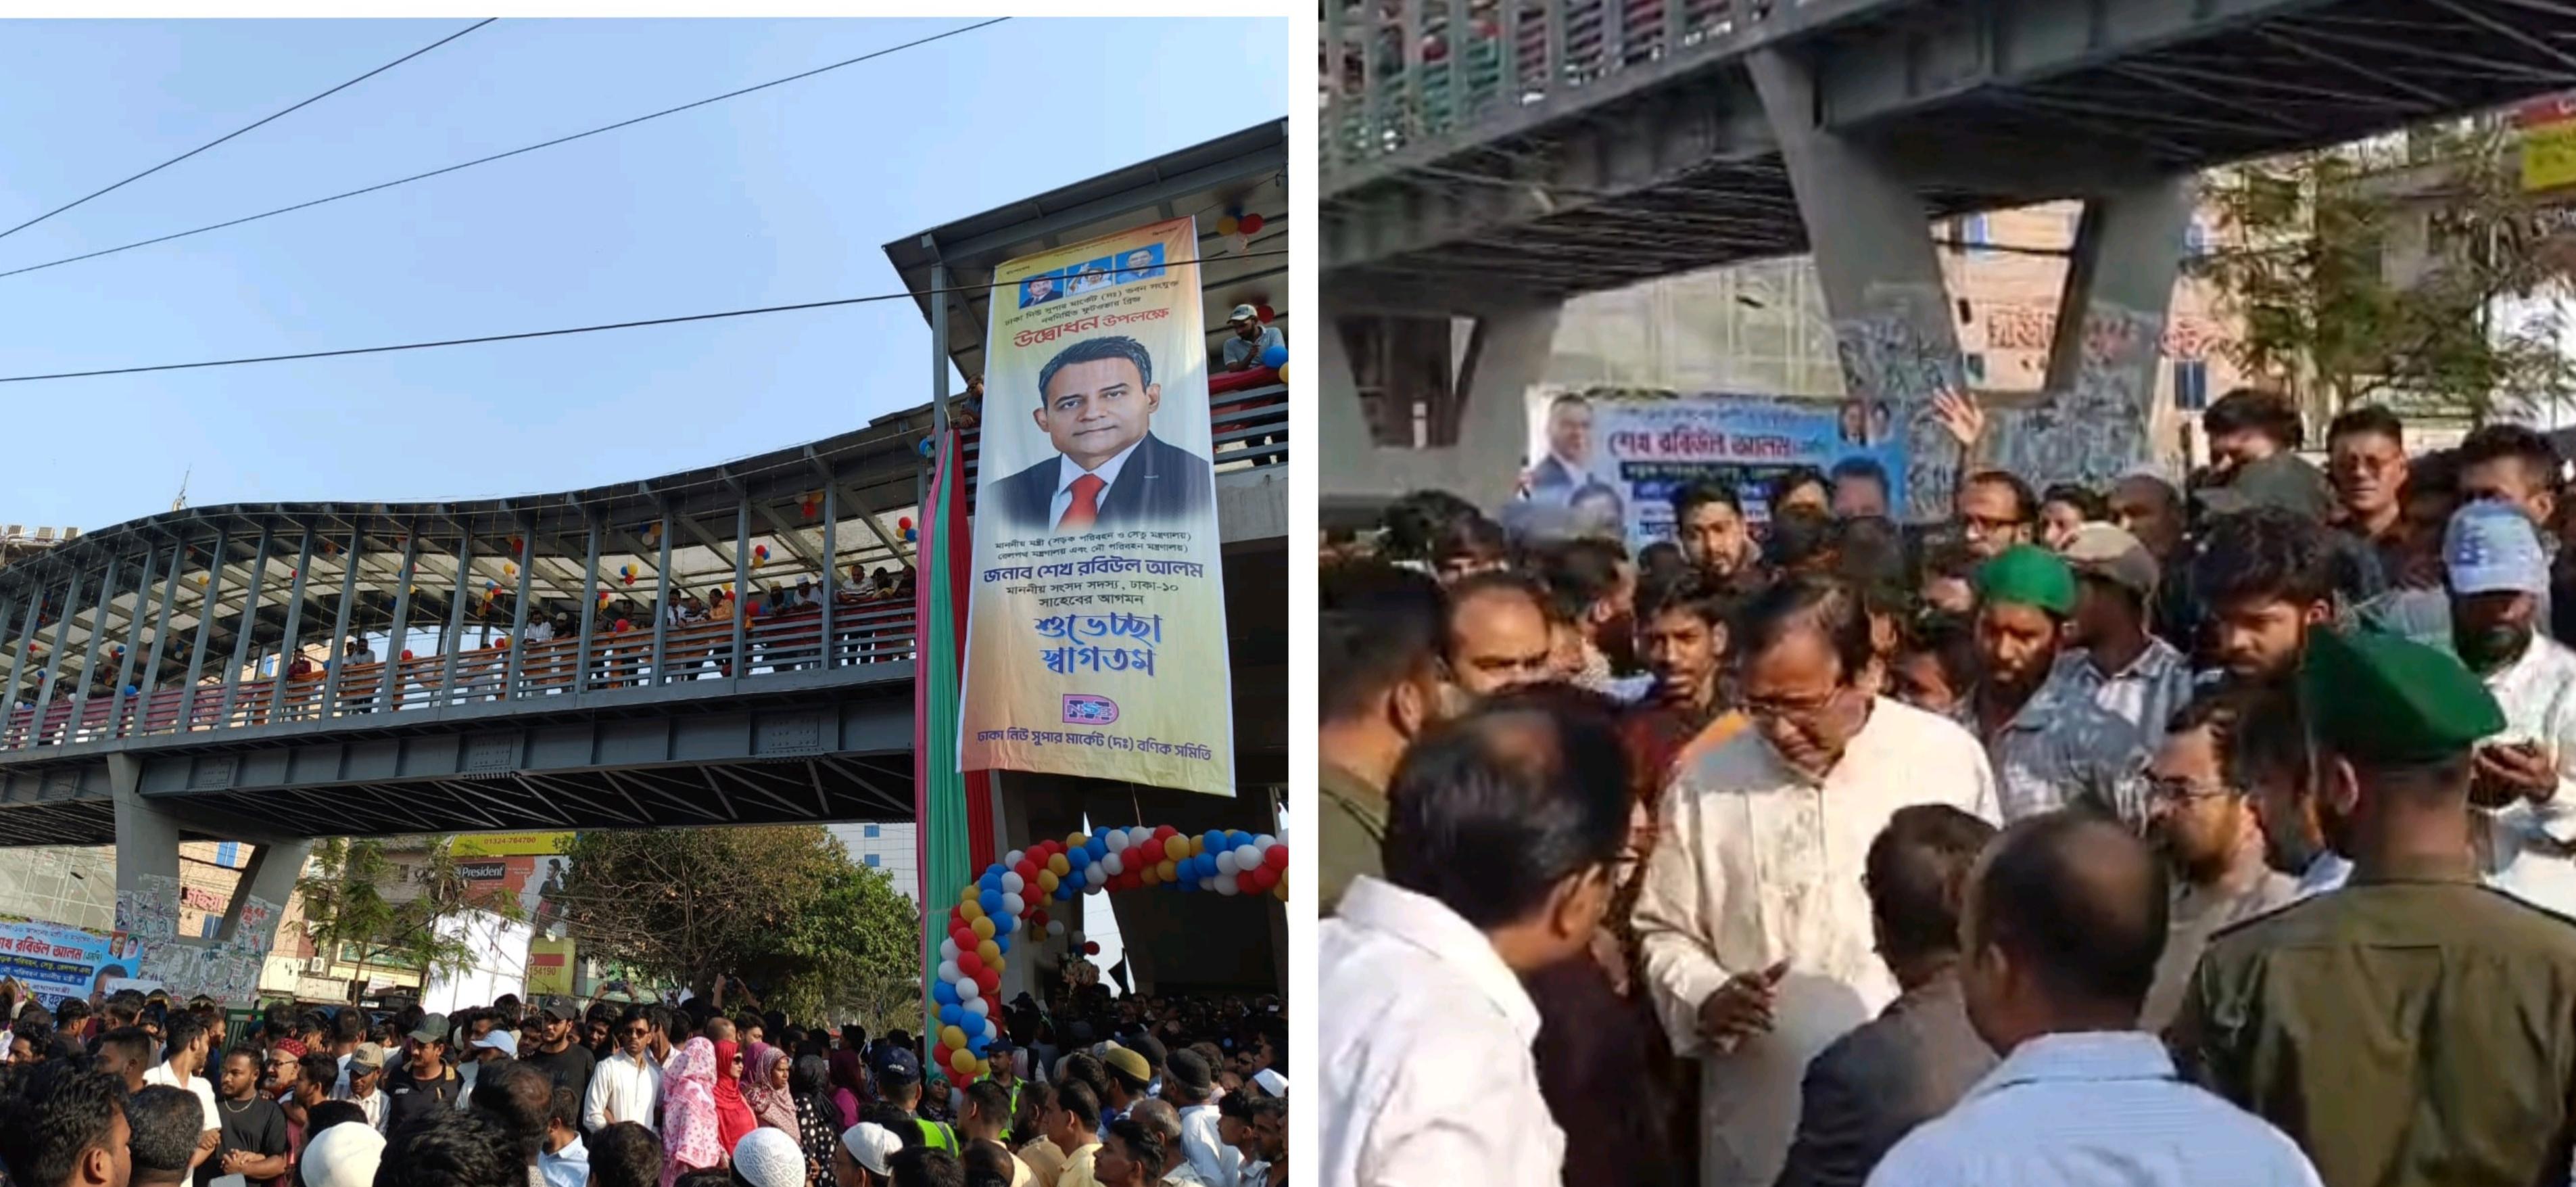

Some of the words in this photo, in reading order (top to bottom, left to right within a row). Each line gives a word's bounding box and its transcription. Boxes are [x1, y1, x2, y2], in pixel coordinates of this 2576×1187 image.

[1045, 303, 1068, 315] সুপার
[1013, 315, 1100, 348] উদ্বোধন
[1103, 308, 1170, 327] উপলক্ষে
[984, 565, 1033, 583] জনাব
[1037, 563, 1074, 578] শেখ
[1076, 555, 1142, 576] রবিউল
[1145, 559, 1204, 578] আলম
[1006, 583, 1046, 595] মাননীয়
[1051, 582, 1082, 593] সংসদ
[1130, 580, 1179, 592] ঢাকা-১০
[1039, 594, 1093, 608] সাহেবের
[1097, 593, 1145, 605] আগমন
[1033, 611, 1164, 648] শুভেচ্ছা
[1040, 645, 1157, 677] স্বাগতম
[977, 730, 1004, 742] ঢাকা
[1007, 726, 1028, 741] নিউ
[1031, 730, 1064, 746] সুপার
[1066, 730, 1105, 747] মার্কেট
[1108, 735, 1134, 751] (দঃ)
[1137, 737, 1172, 755] বণিক
[1174, 742, 1212, 761] সমিতি
[462, 865, 503, 877] President
[16, 936, 51, 956] রবিউল
[53, 946, 83, 960] আলম
